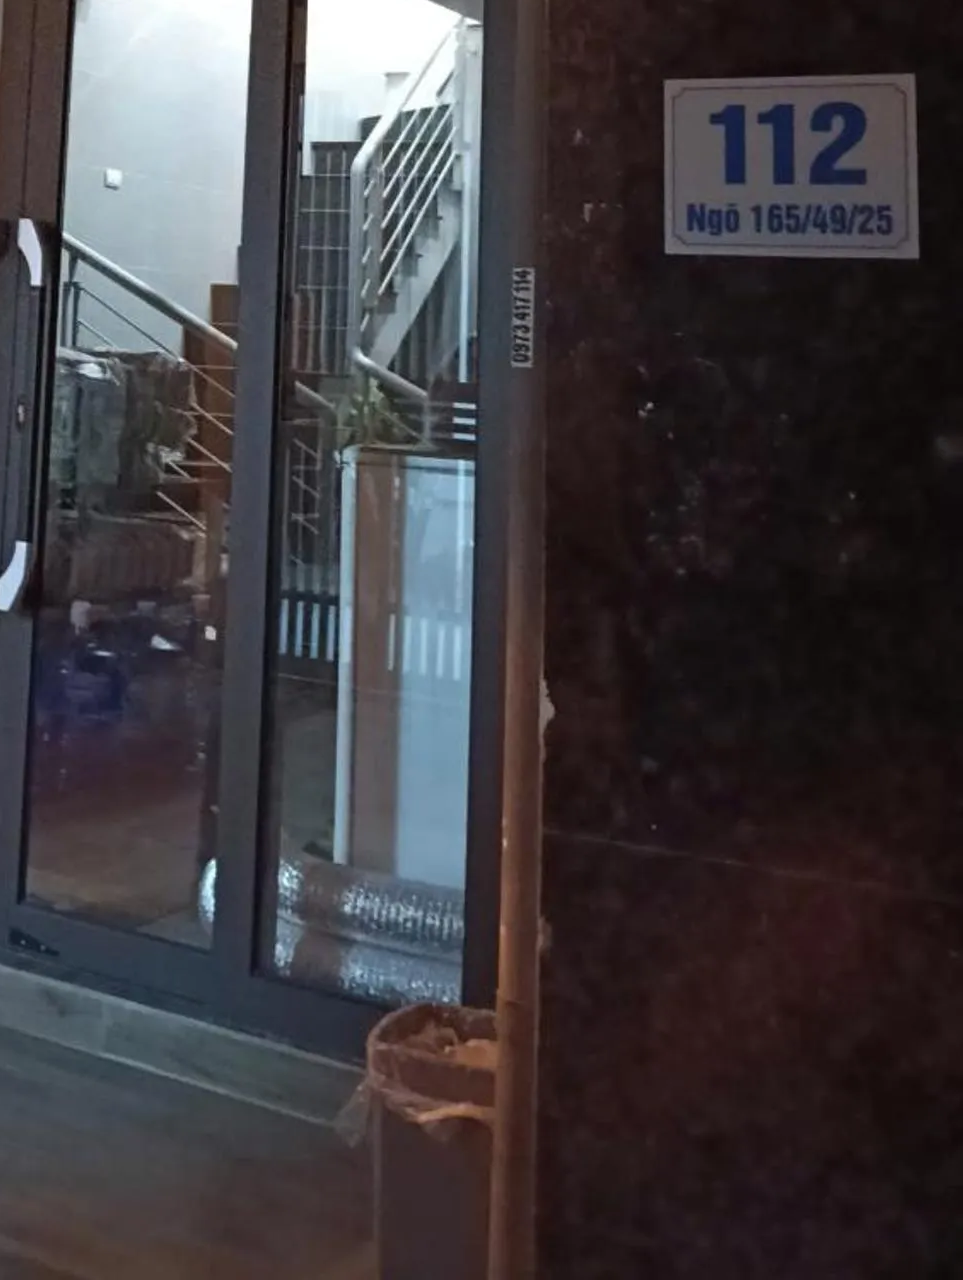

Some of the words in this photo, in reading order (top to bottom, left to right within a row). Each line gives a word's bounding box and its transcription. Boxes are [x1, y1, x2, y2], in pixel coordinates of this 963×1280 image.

[709, 101, 867, 185] 112
[687, 202, 740, 236] Ngõ
[750, 204, 893, 235] 165/49/25
